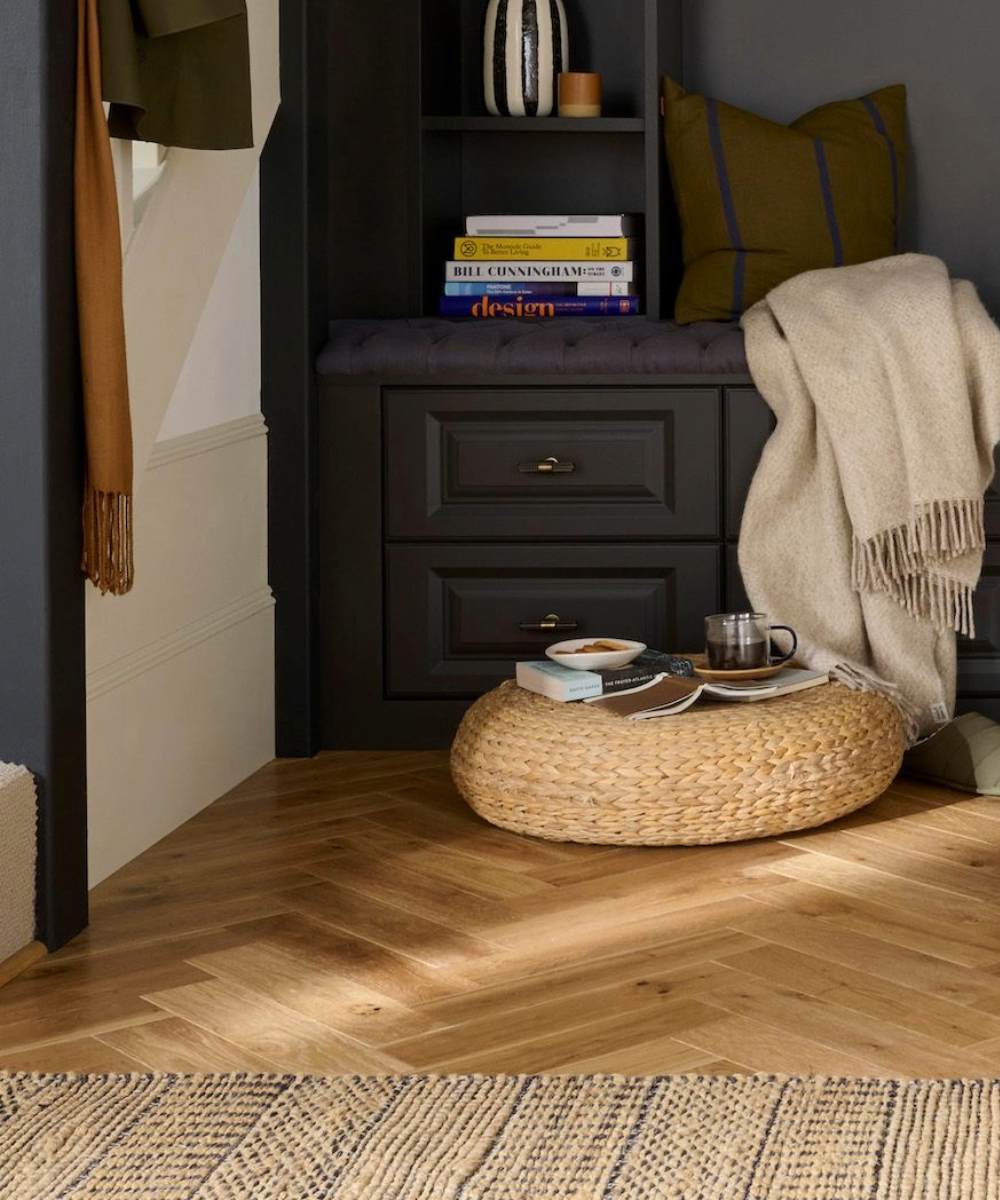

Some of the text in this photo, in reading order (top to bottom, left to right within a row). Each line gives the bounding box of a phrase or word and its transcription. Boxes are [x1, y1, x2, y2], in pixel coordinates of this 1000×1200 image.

[454, 267, 586, 277] BILL CUNNINGHAM:
[471, 295, 555, 317] design
